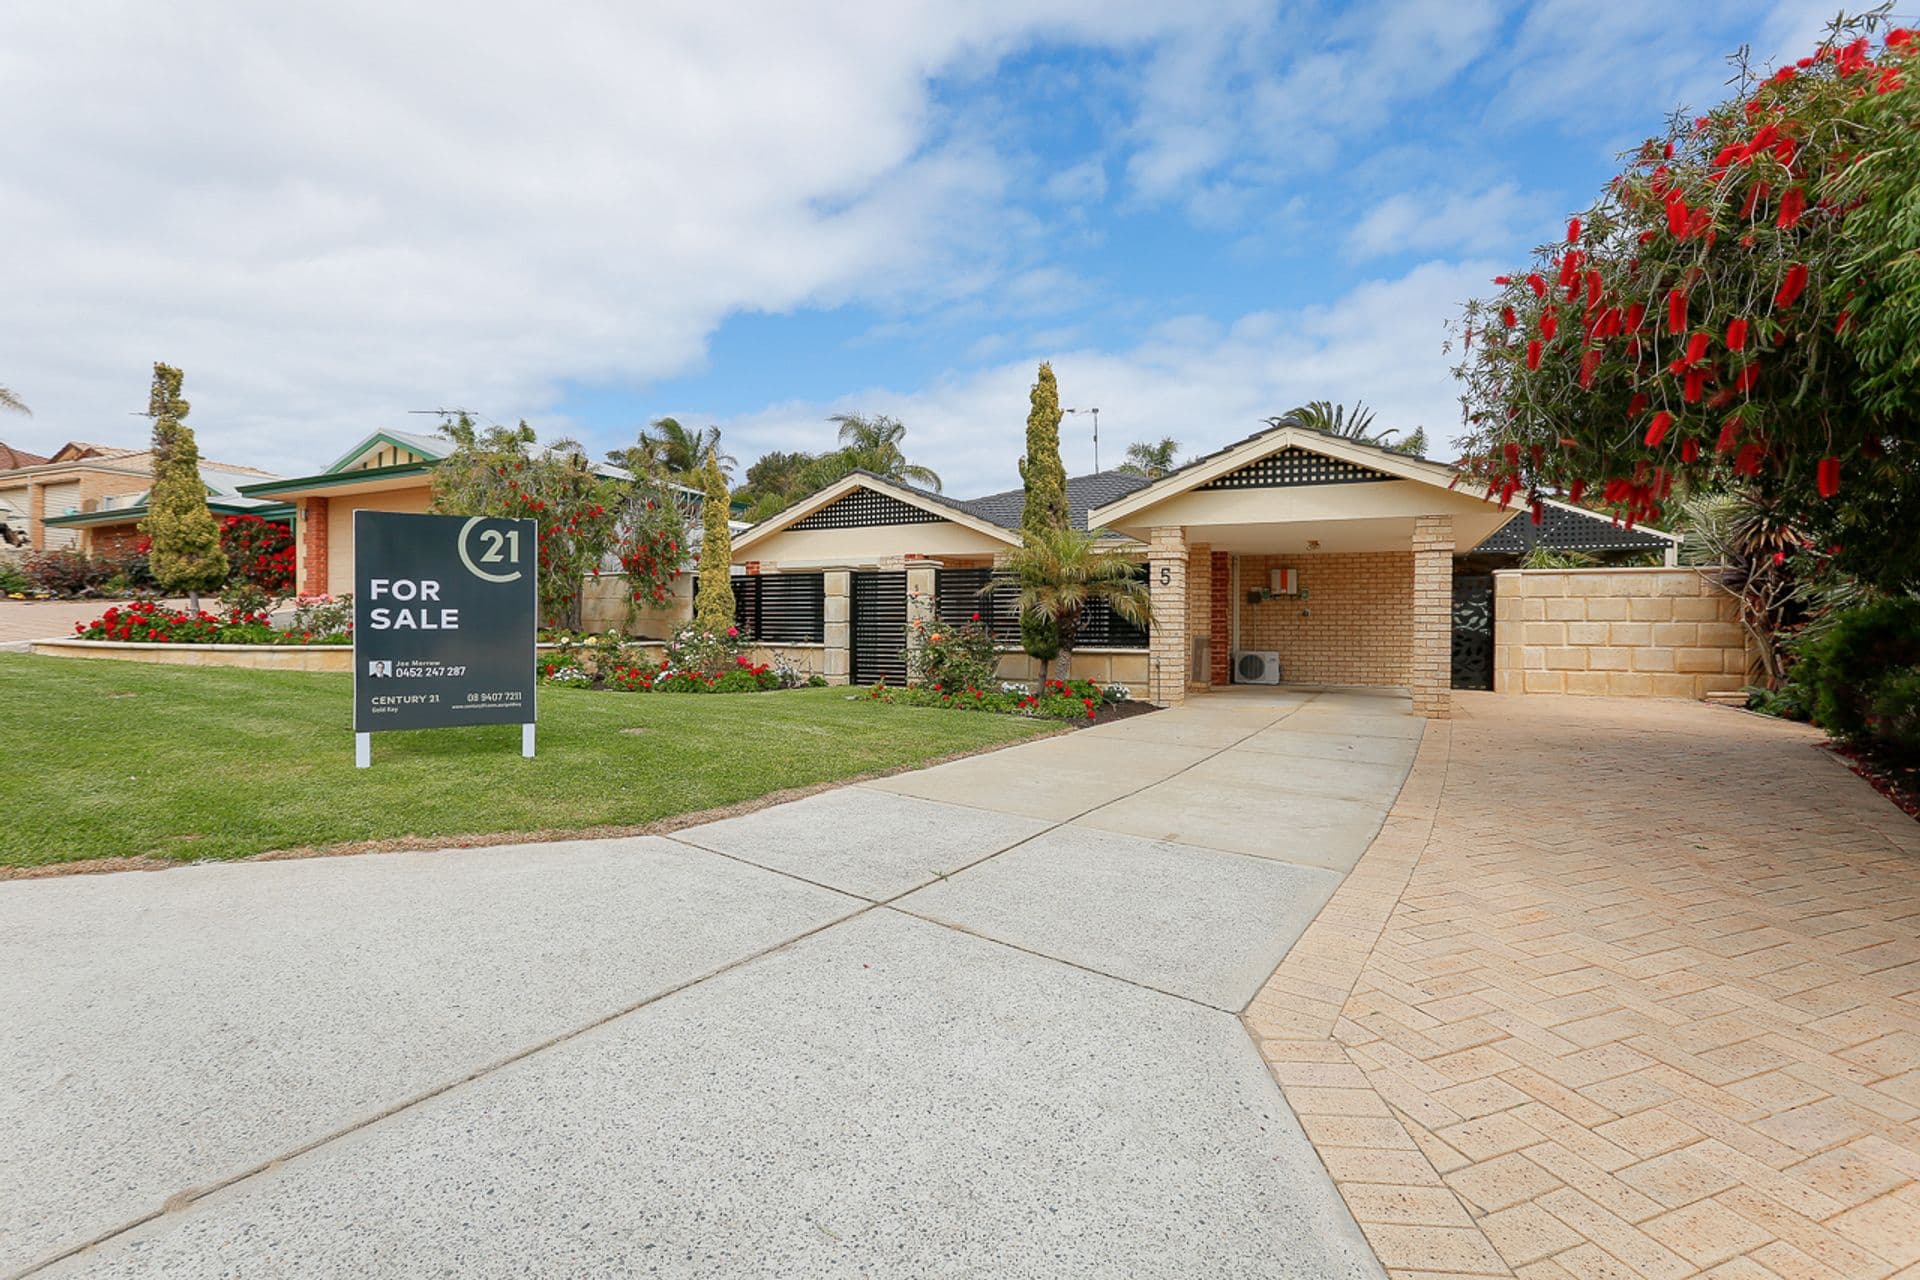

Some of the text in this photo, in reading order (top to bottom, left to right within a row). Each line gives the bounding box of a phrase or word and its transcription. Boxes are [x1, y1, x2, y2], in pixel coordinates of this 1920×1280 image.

[480, 529, 519, 563] 21
[1160, 567, 1170, 585] 5
[371, 579, 440, 601] FOR
[370, 608, 459, 630] SALE
[395, 665, 466, 678] 0452 247 287
[371, 694, 440, 705] CENTURY 21
